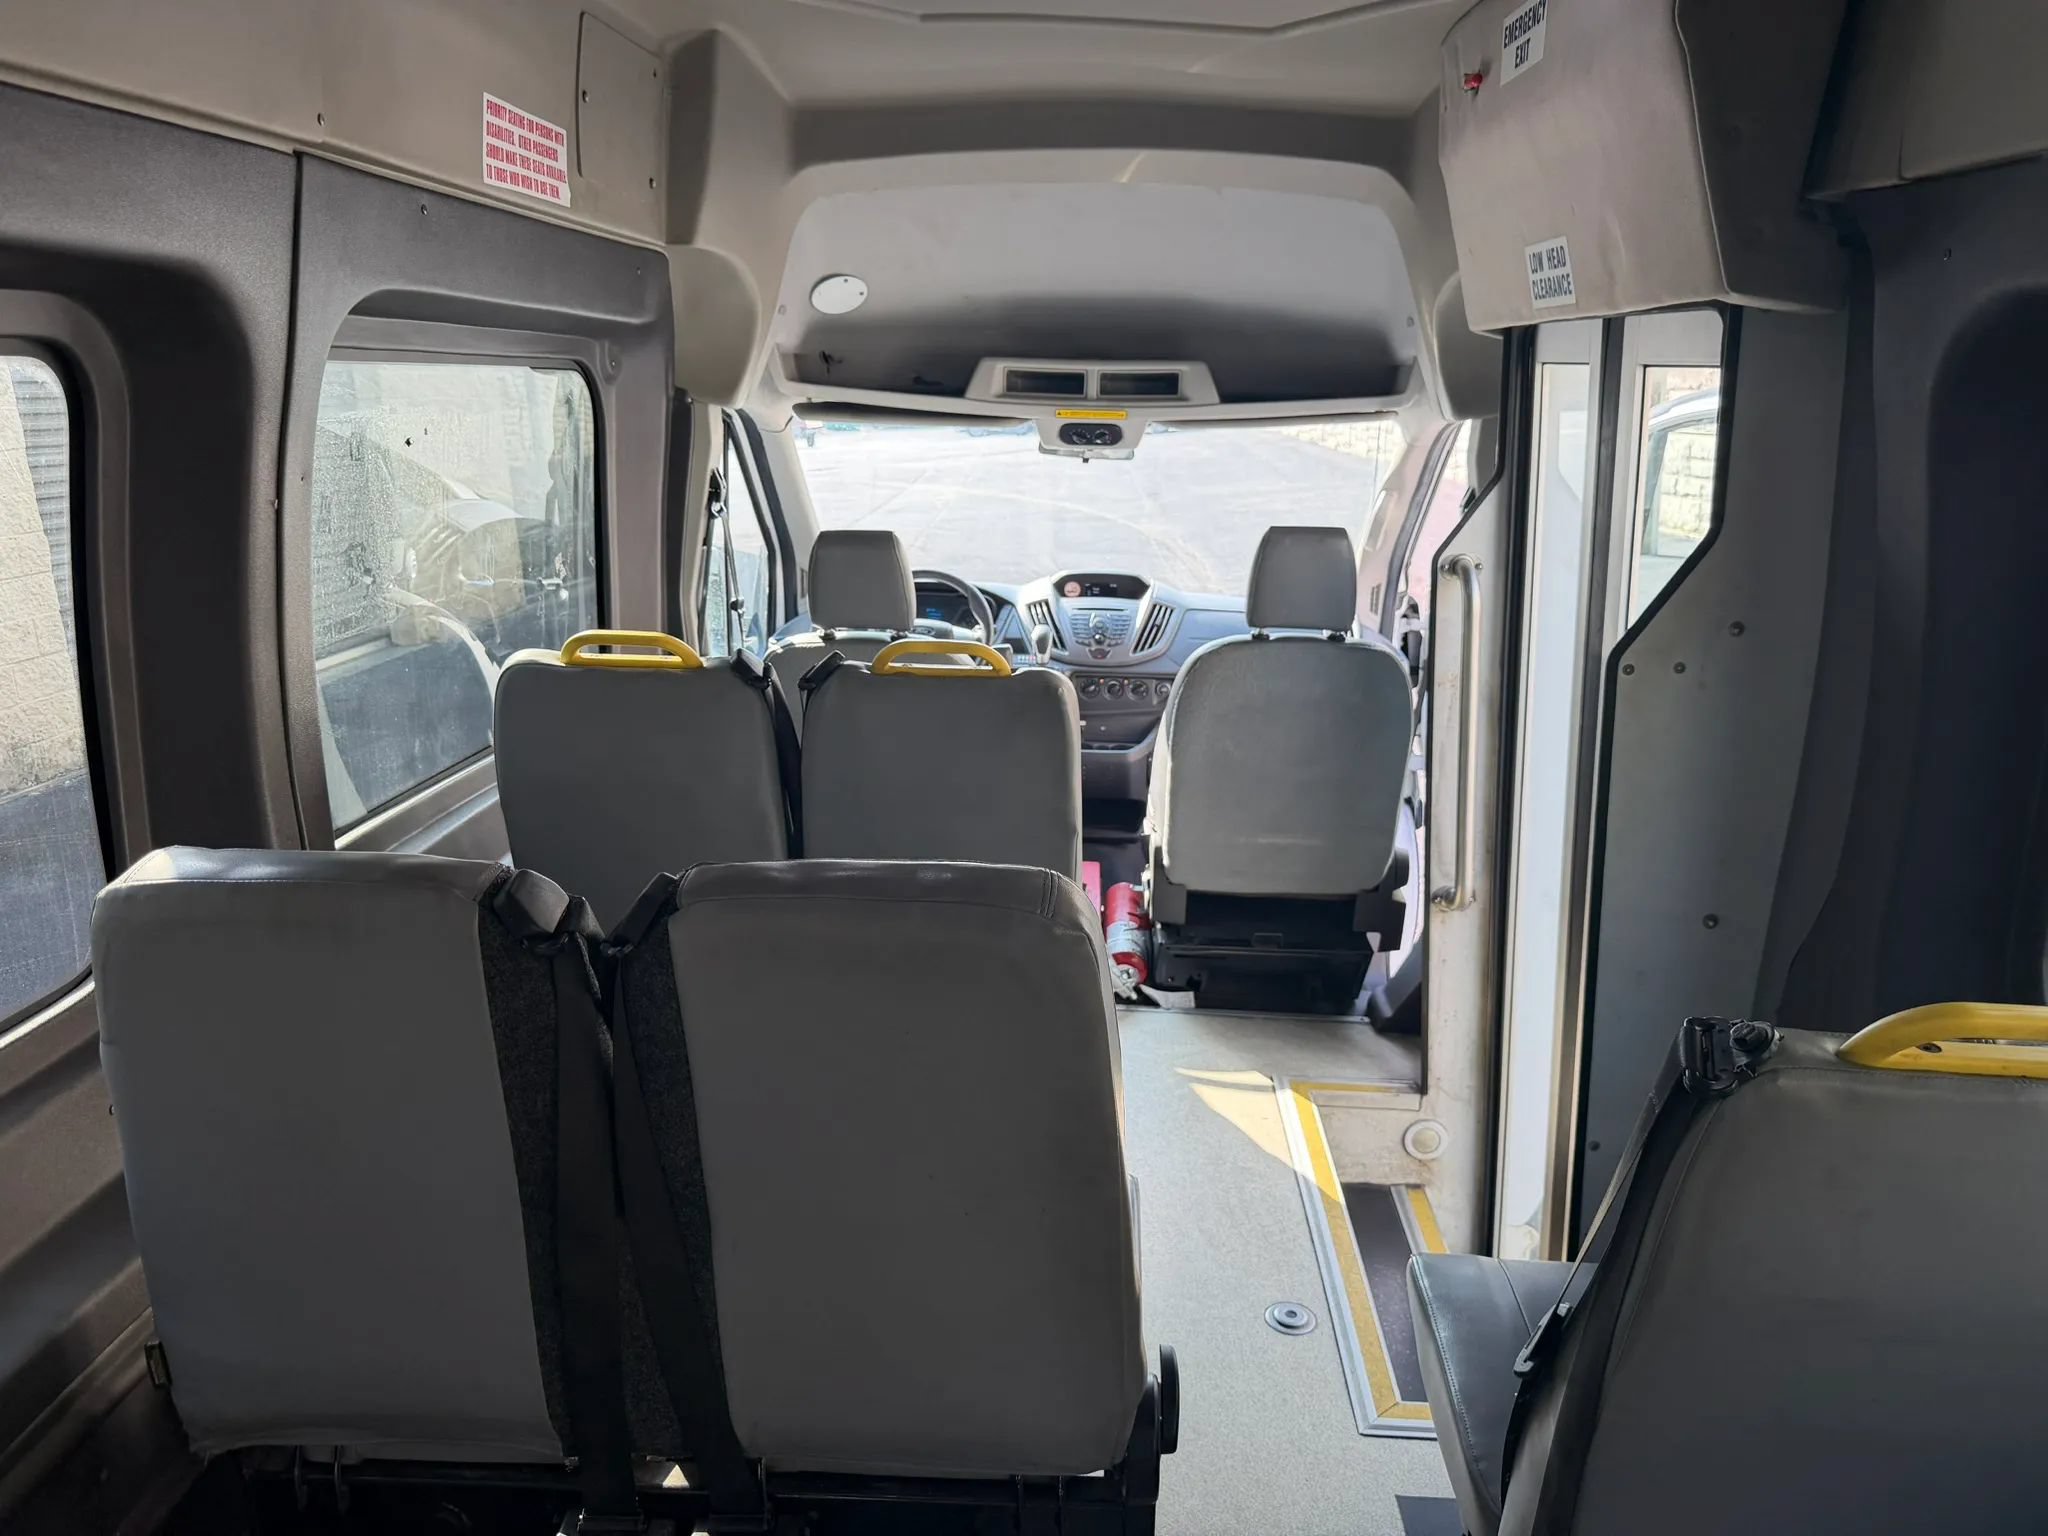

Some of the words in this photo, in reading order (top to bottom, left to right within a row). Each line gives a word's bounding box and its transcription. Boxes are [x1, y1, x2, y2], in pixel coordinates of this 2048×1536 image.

[1504, 0, 1546, 49] EMERGENCY
[1515, 37, 1531, 69] EXIT
[487, 99, 507, 122] PRIORITY
[508, 109, 525, 130] SEATING
[526, 118, 534, 134] FOR
[535, 122, 553, 142] PERSONS
[554, 130, 564, 147] WITH
[486, 142, 504, 162] SHOULD
[505, 149, 518, 167] MAKE
[519, 154, 531, 171] THESE
[532, 159, 545, 176] SEATS
[518, 134, 531, 152] OTHER
[532, 140, 558, 162] PASSENGERS
[486, 163, 492, 180] TO
[493, 166, 508, 184] THOSE
[509, 171, 519, 187] WHO
[533, 178, 539, 193] TO
[540, 180, 548, 196] USE
[1529, 251, 1543, 274] LOW
[1546, 245, 1566, 270] HEAD
[1532, 273, 1572, 300] CLEARANCE
